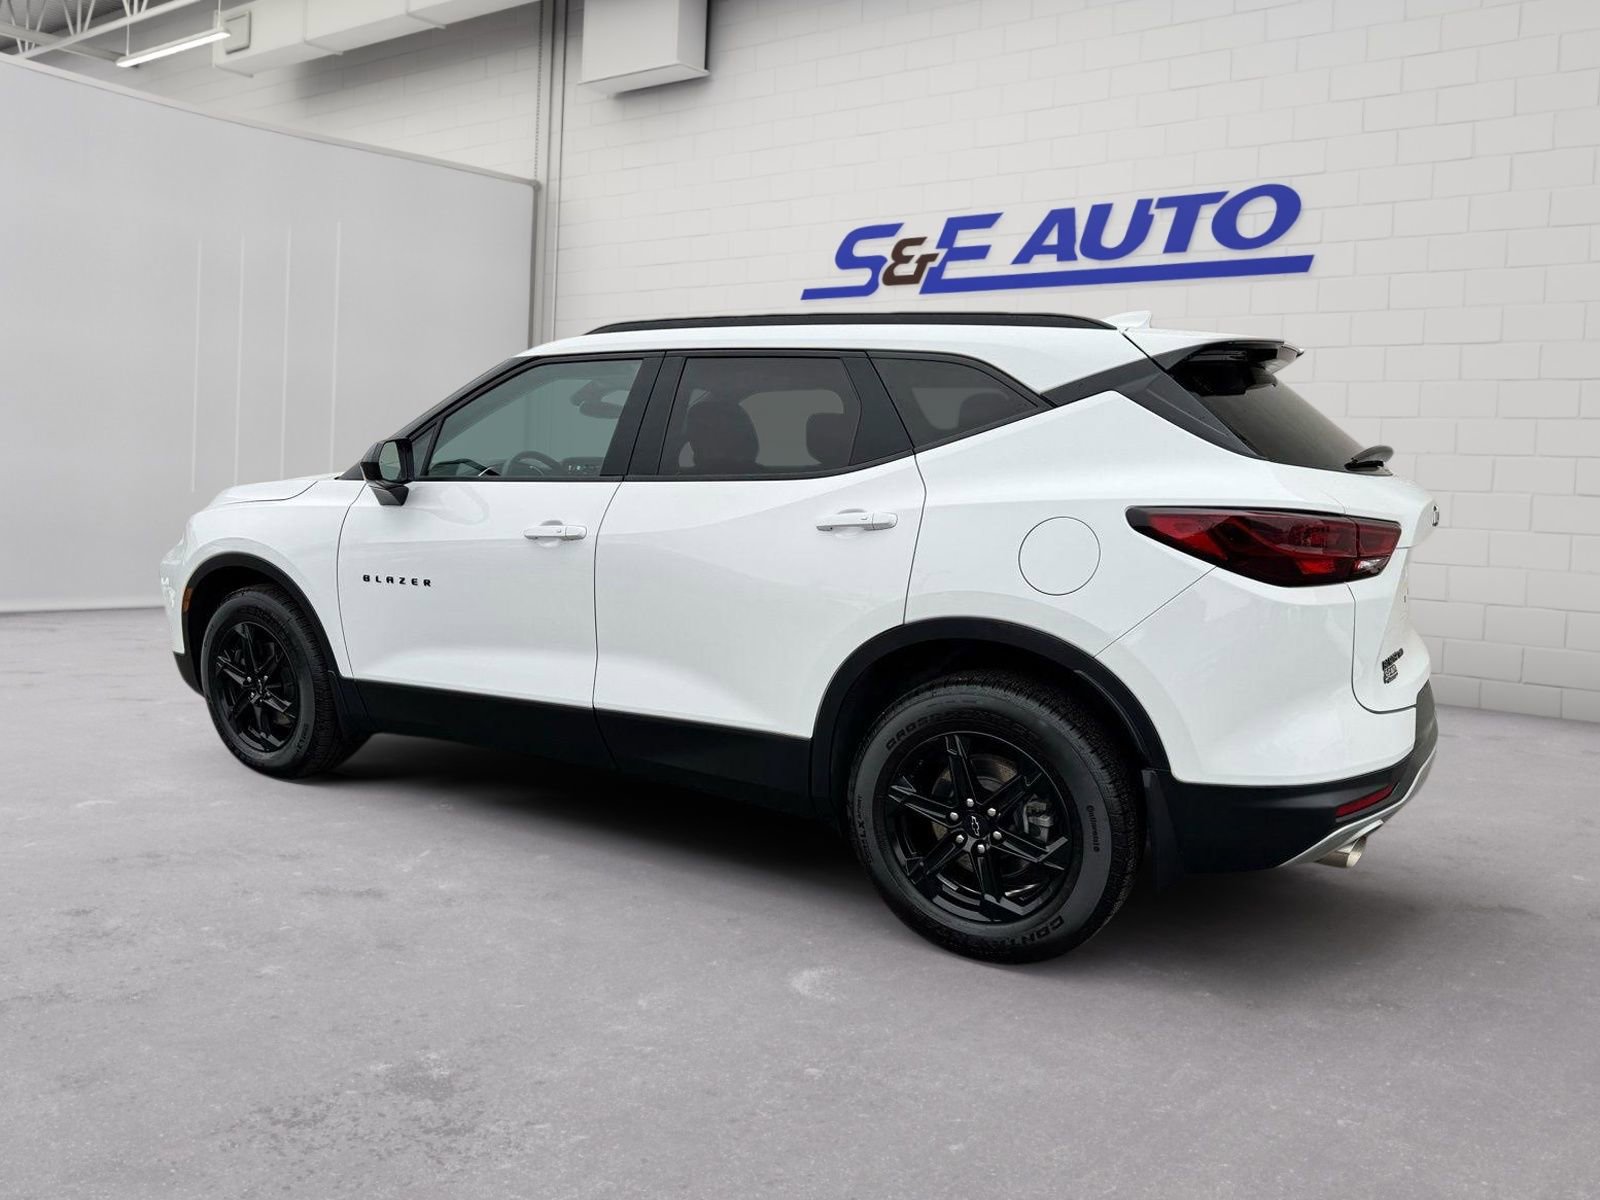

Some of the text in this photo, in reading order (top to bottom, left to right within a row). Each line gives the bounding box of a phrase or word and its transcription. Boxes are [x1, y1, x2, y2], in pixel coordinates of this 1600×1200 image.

[802, 184, 1302, 300] S&E AUTO
[363, 574, 432, 587] BLAZER
